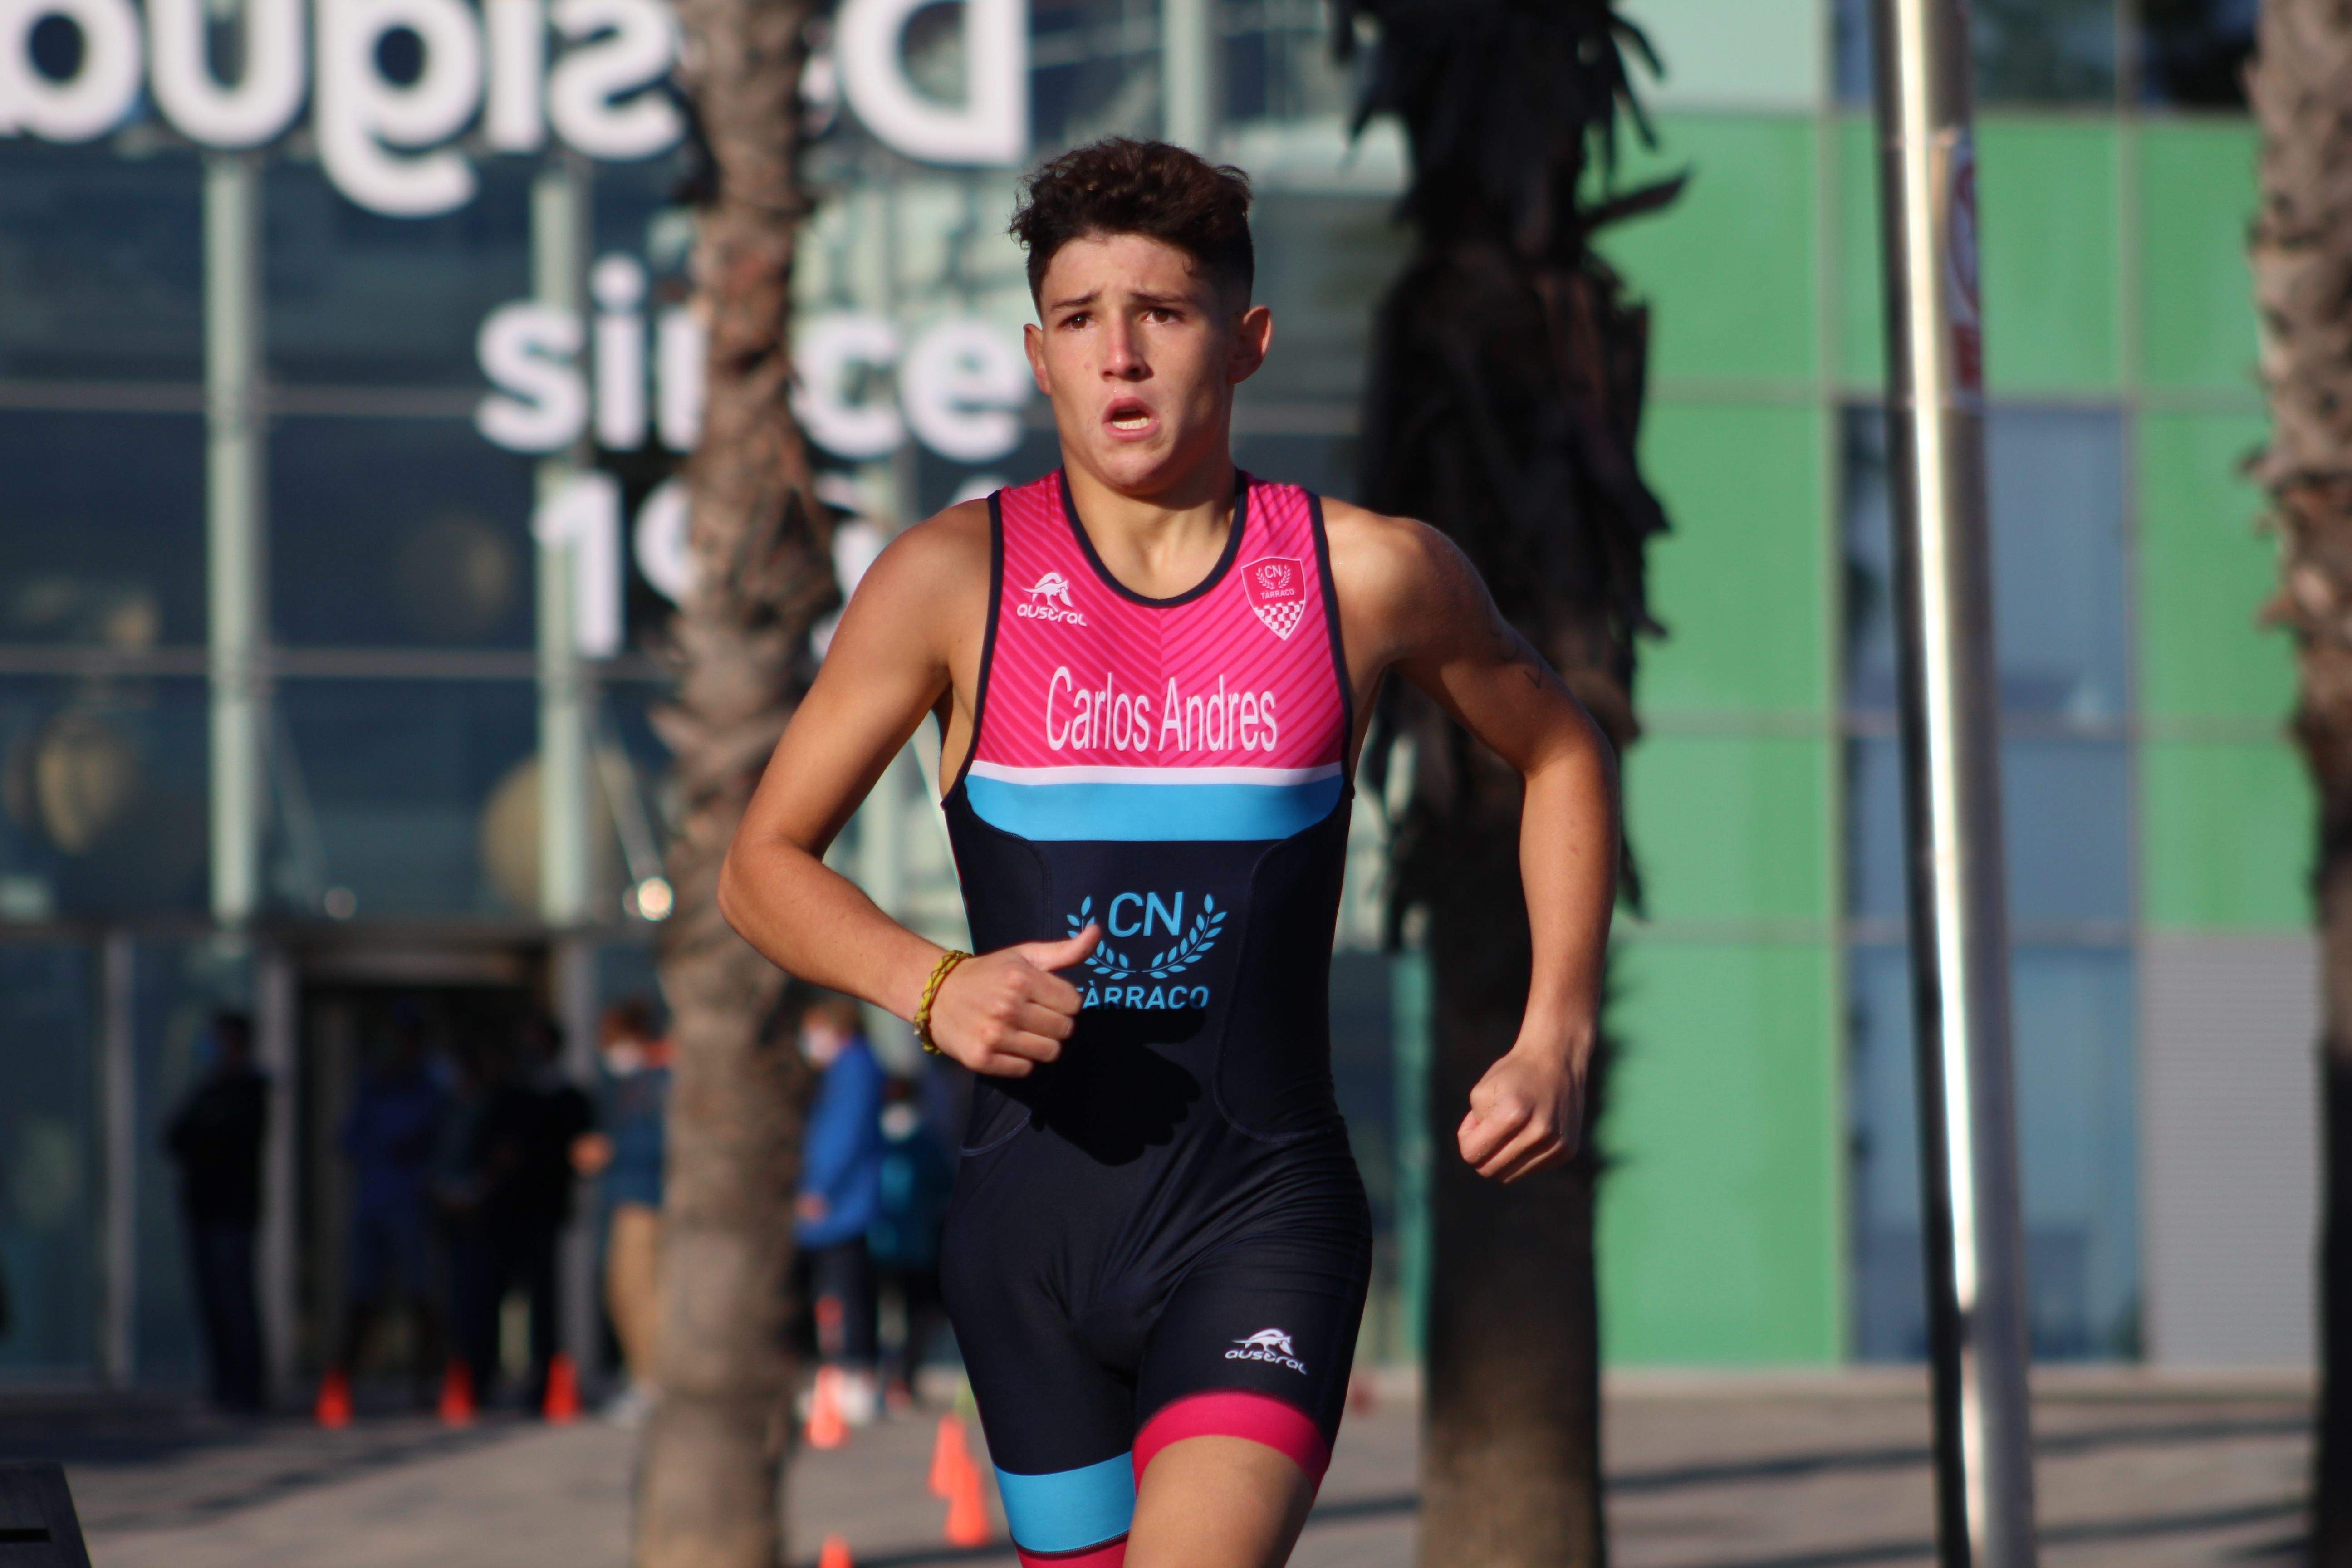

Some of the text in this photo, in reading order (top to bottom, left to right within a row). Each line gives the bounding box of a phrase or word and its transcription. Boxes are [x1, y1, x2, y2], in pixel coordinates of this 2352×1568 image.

[1264, 564, 1282, 578] CN
[1016, 604, 1087, 627] austral
[1046, 666, 1277, 752] Carlos Andres
[1108, 891, 1184, 937] CN
[1076, 980, 1210, 1009] ÀRRACO
[1225, 1349, 1307, 1376] austral
